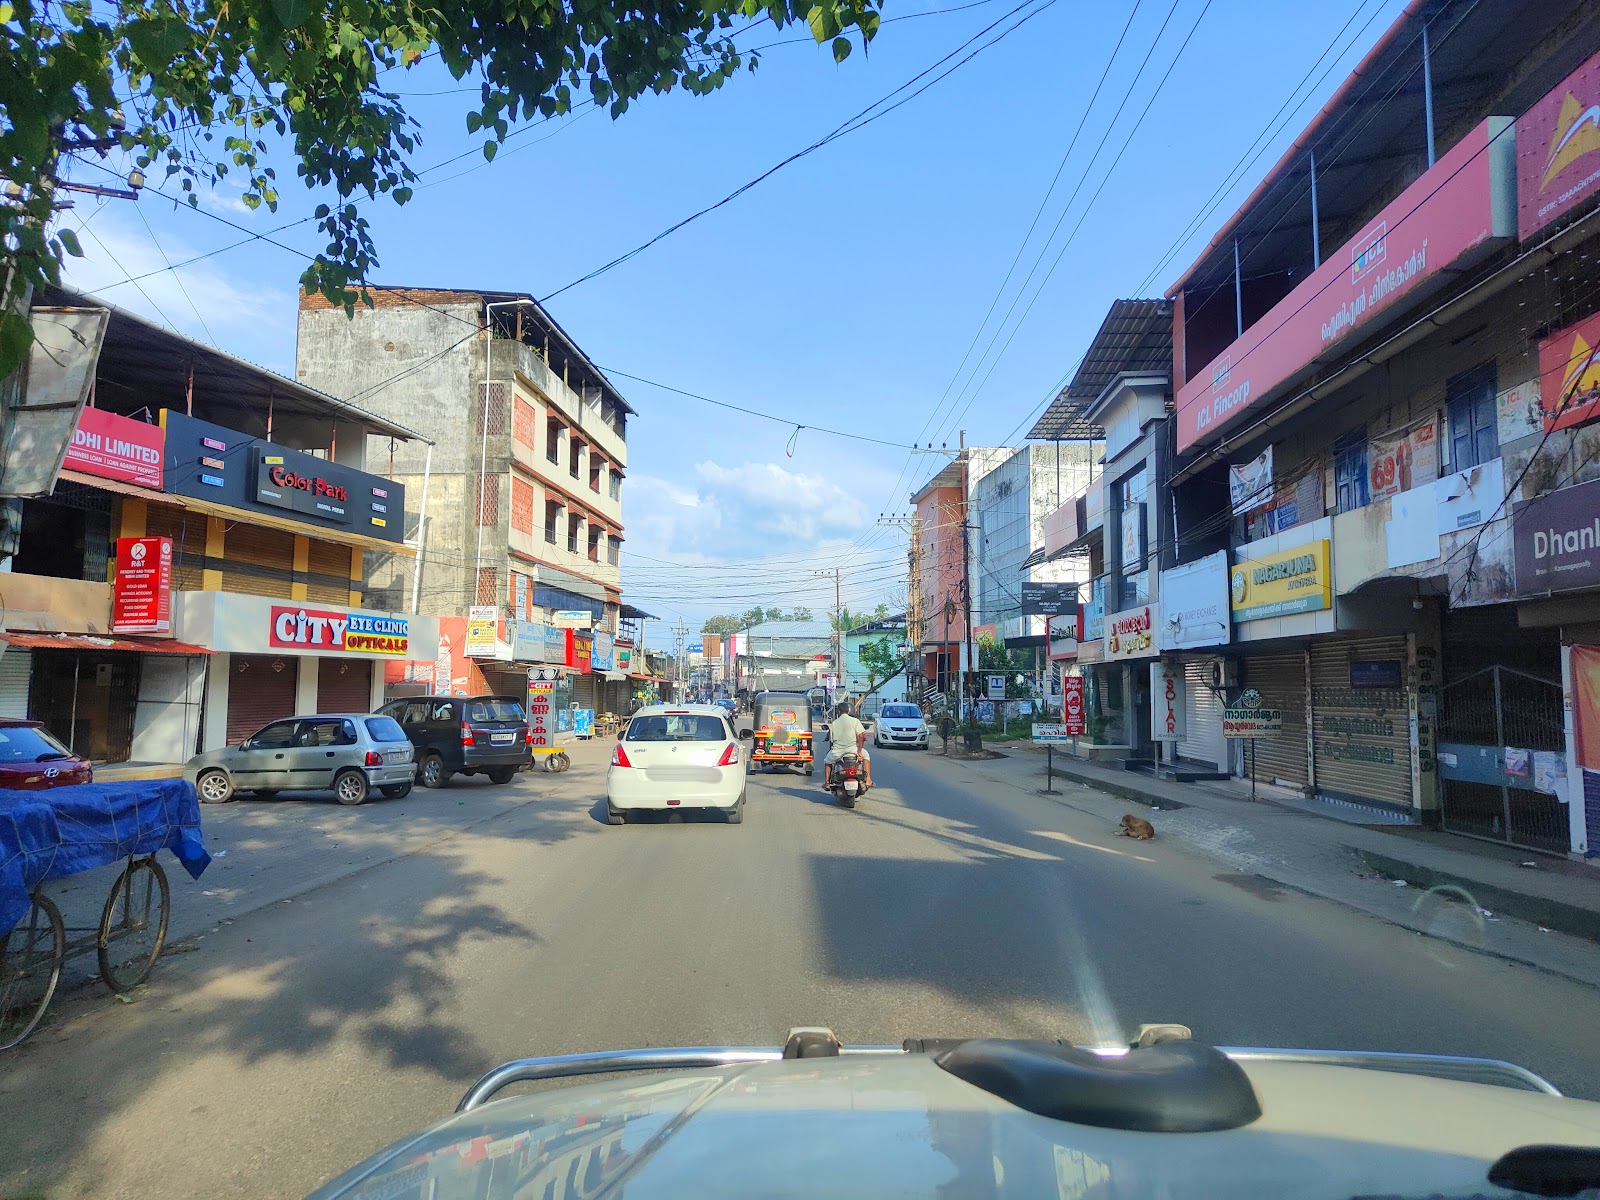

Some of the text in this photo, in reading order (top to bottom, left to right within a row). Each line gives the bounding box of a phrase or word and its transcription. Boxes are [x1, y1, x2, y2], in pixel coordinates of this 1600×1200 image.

[1197, 380, 1250, 431] ICL Fincorp
[68, 449, 103, 463] BUSINESS LOAN
[105, 437, 160, 464] LIMITED
[107, 459, 120, 467] LOAN
[271, 466, 348, 501] Color Park
[1371, 456, 1395, 490] 69
[1534, 517, 1600, 559] Dhanl
[1252, 553, 1316, 585] NAGARJUNA
[349, 617, 408, 636] EYE CLINIC
[347, 635, 408, 652] OPTICALS
[1165, 678, 1177, 733] SOLAR
